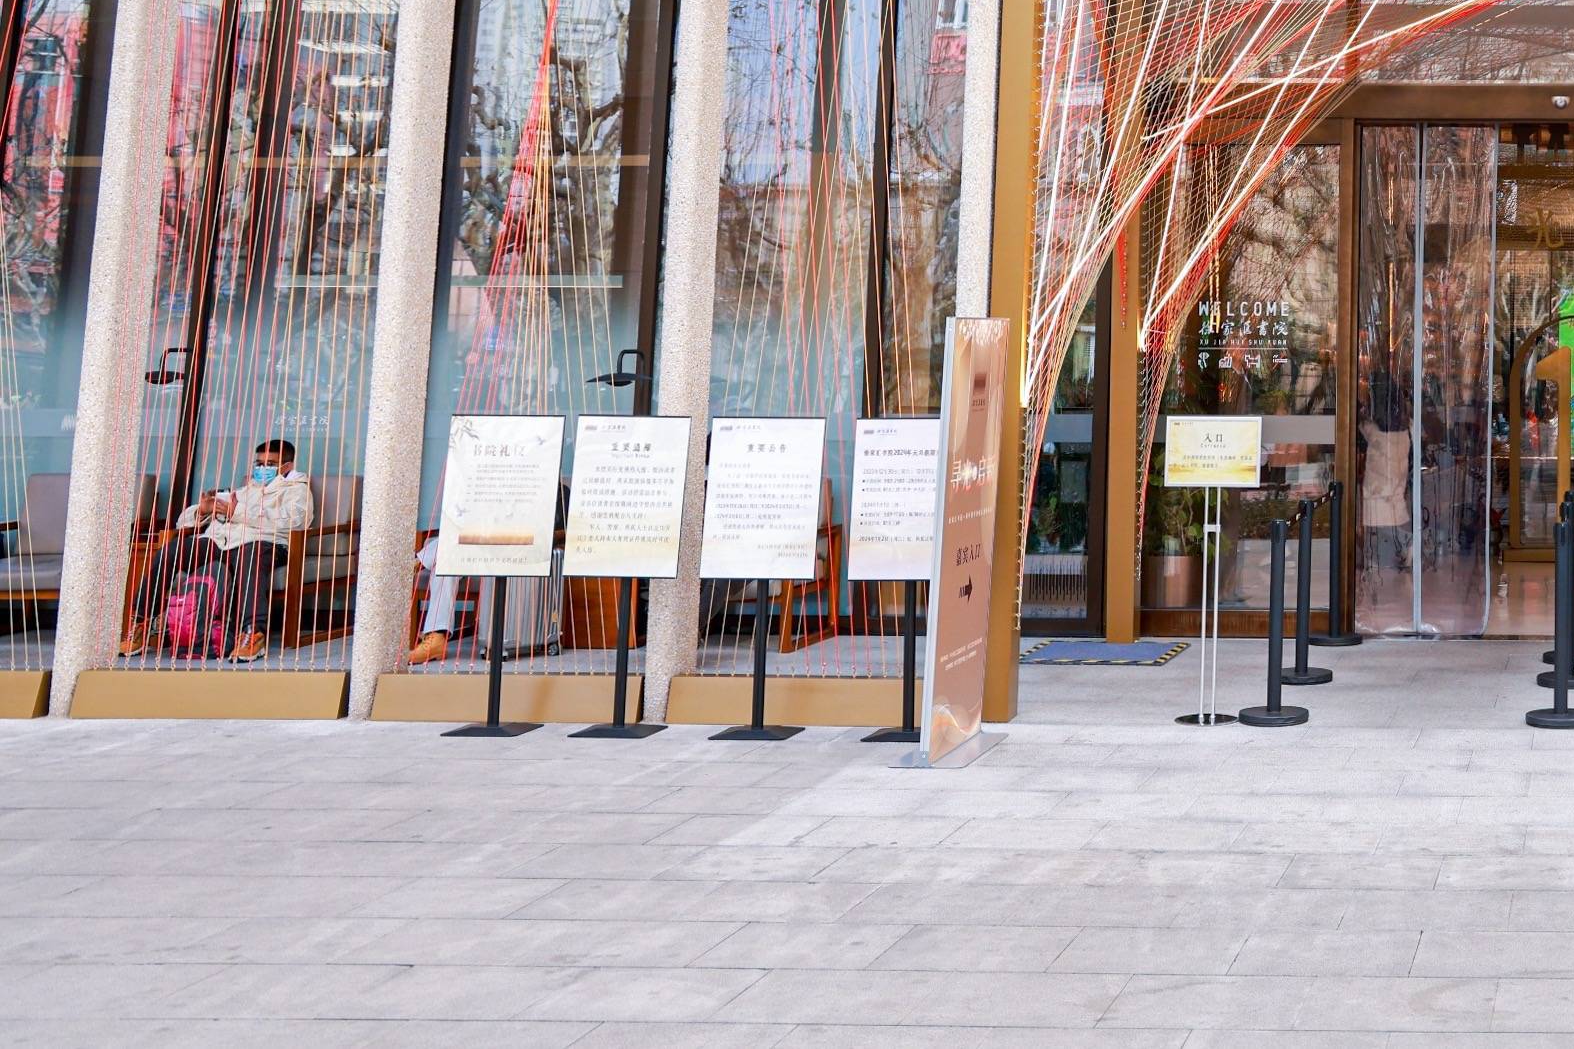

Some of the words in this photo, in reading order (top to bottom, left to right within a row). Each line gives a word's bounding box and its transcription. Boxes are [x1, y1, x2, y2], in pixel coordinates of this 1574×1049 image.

[1198, 301, 1290, 317] WELCOME
[1204, 432, 1223, 443] 入口
[747, 444, 787, 453] 重要公告
[955, 543, 982, 567] 嘉宾入口
